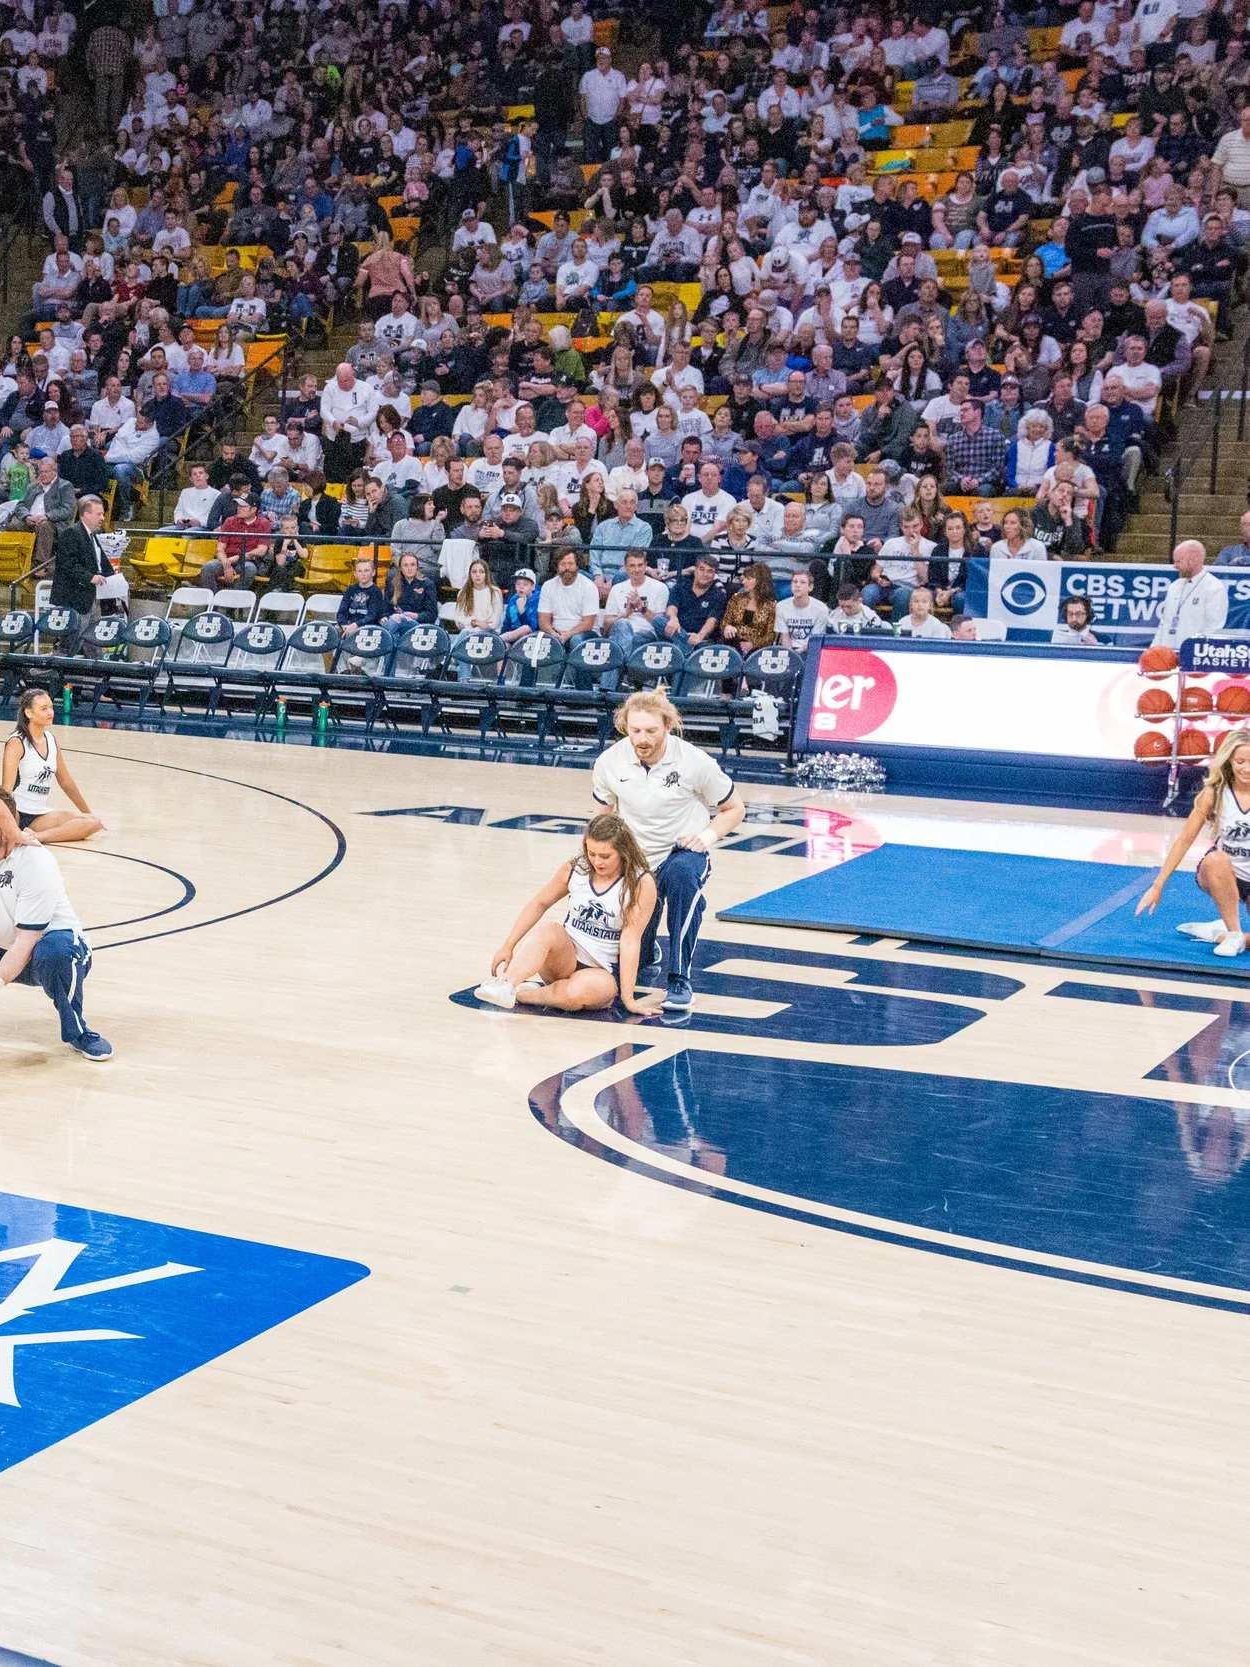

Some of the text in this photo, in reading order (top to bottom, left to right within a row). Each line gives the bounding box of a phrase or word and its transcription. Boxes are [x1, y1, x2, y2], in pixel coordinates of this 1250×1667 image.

[691, 511, 718, 520] STATE
[1066, 573, 1126, 597] CBS
[571, 917, 622, 940] UTAH STATE
